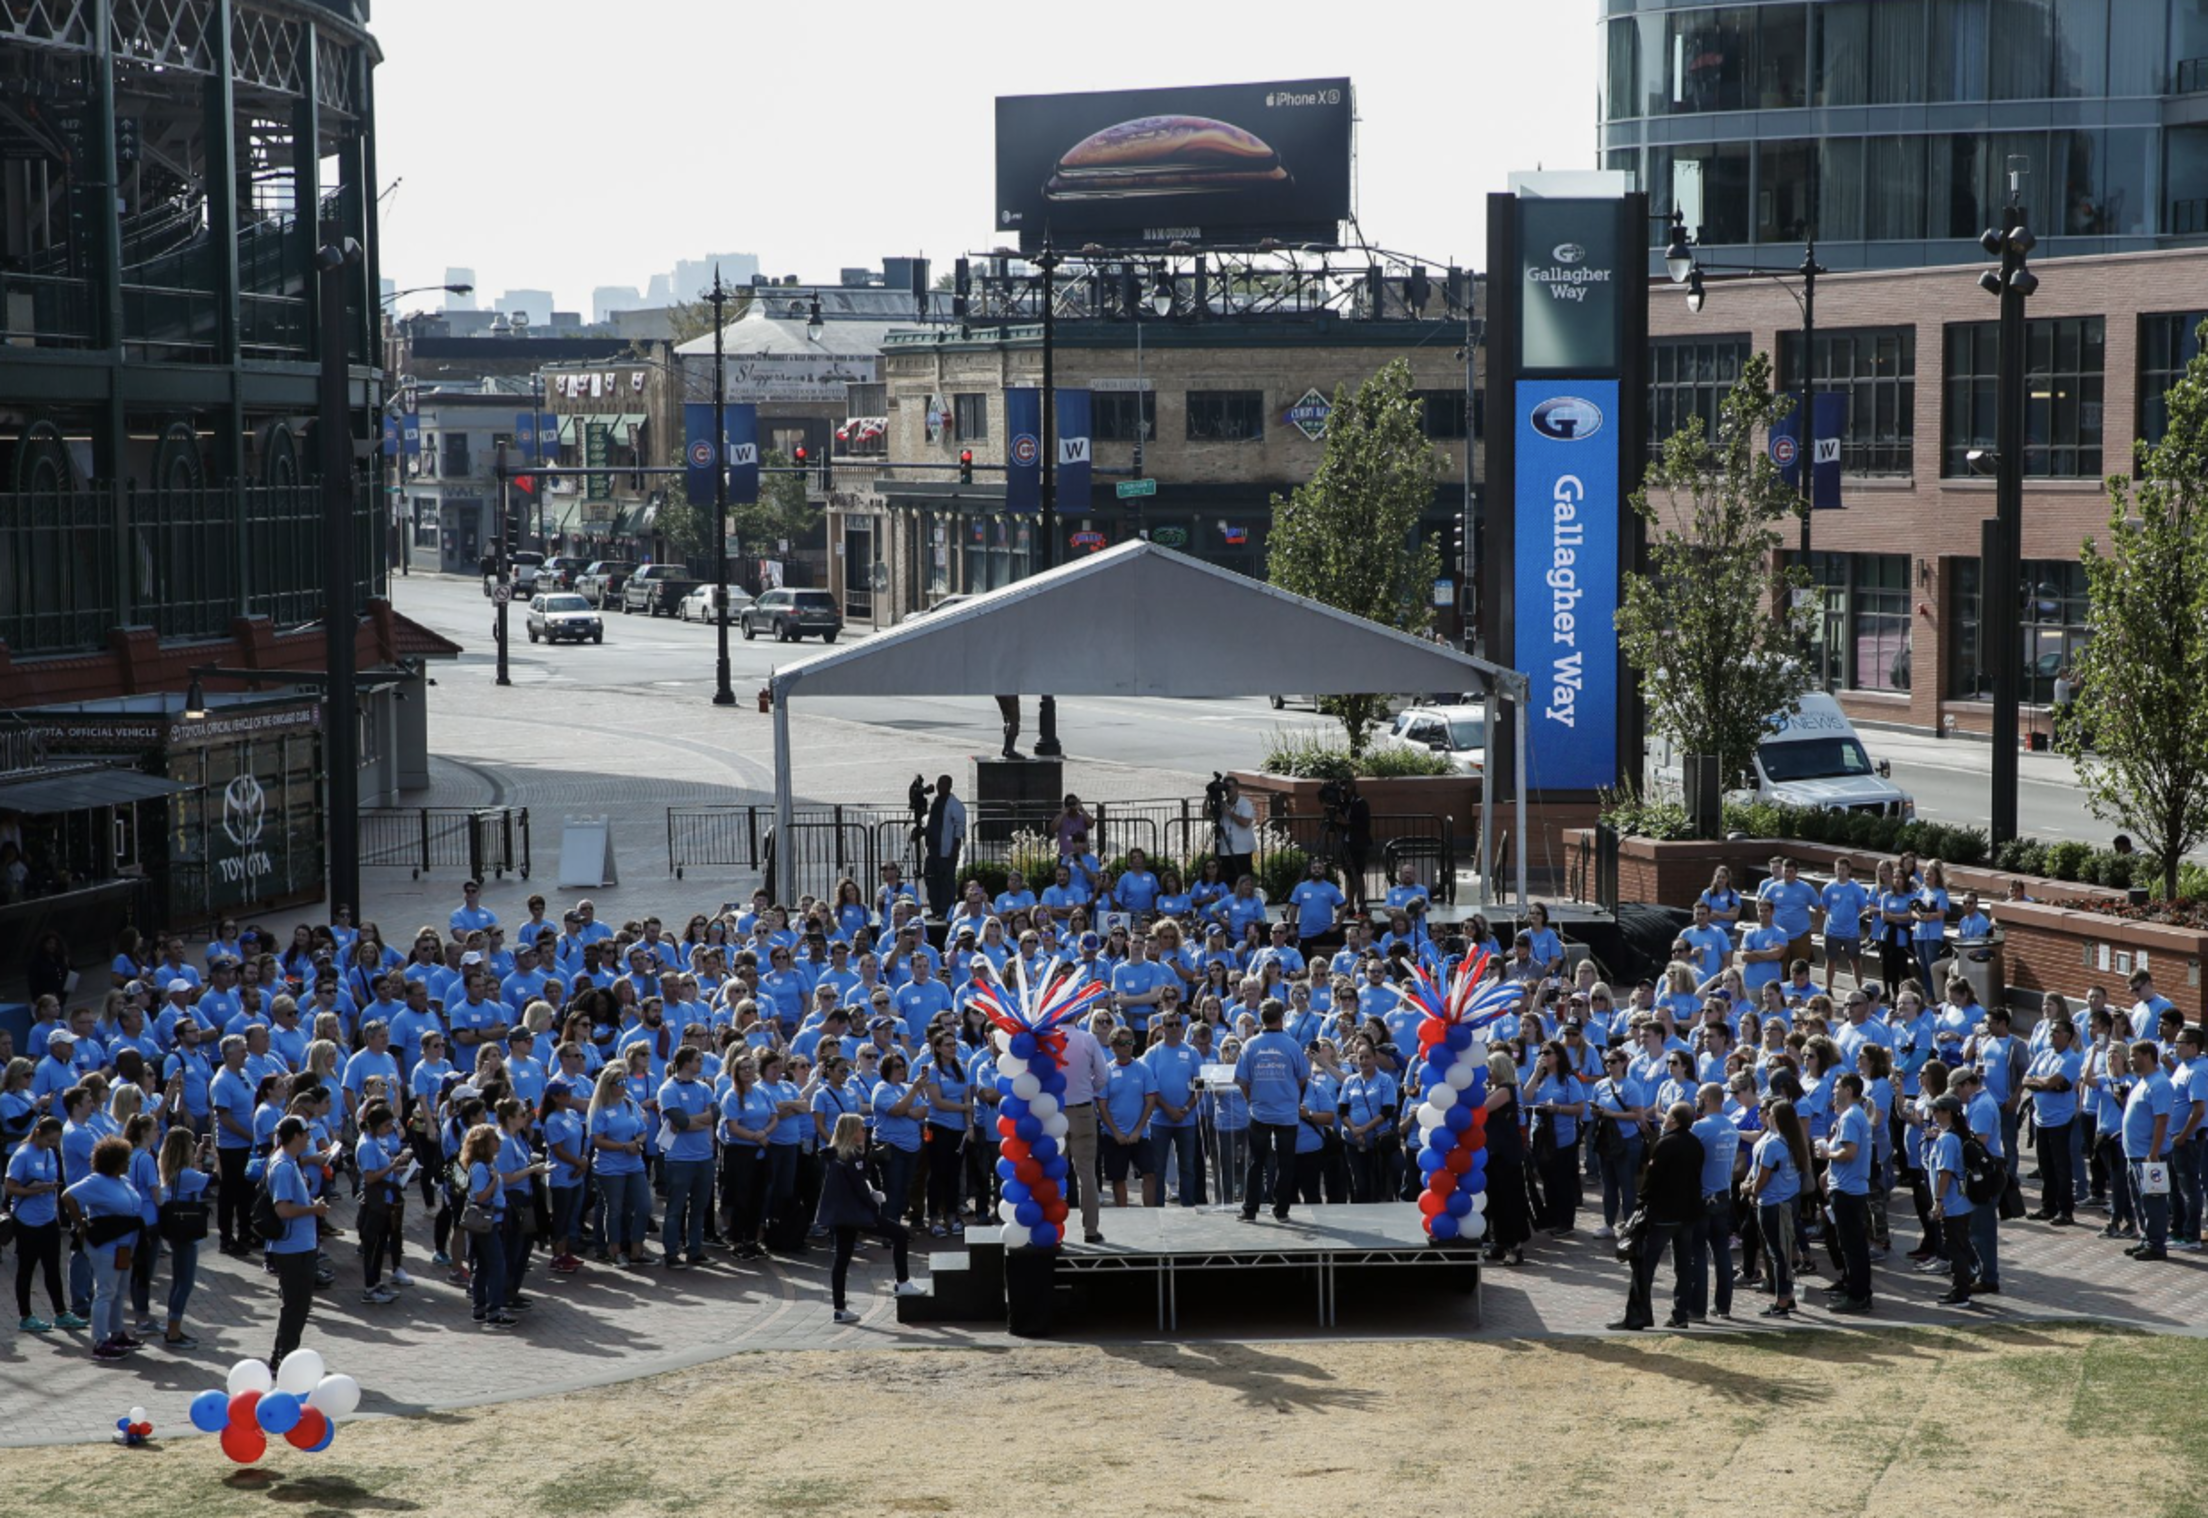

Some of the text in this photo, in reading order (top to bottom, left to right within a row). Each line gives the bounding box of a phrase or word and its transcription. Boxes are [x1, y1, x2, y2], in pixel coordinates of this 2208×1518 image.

[1276, 92, 1316, 106] iPhone
[1527, 266, 1611, 284] Gallagher
[1550, 284, 1588, 302] Way
[735, 446, 752, 462] W
[1065, 440, 1084, 459] W
[1820, 442, 1836, 459] W
[1546, 475, 1584, 727] Gallagher Way
[180, 725, 206, 740] TOYOTA
[207, 721, 232, 735] OFFICIAL
[1790, 717, 1844, 729] NEWS
[67, 728, 114, 737] OFFICIAL
[115, 728, 158, 737] VEHICLE
[219, 851, 272, 883] TOYOTA
